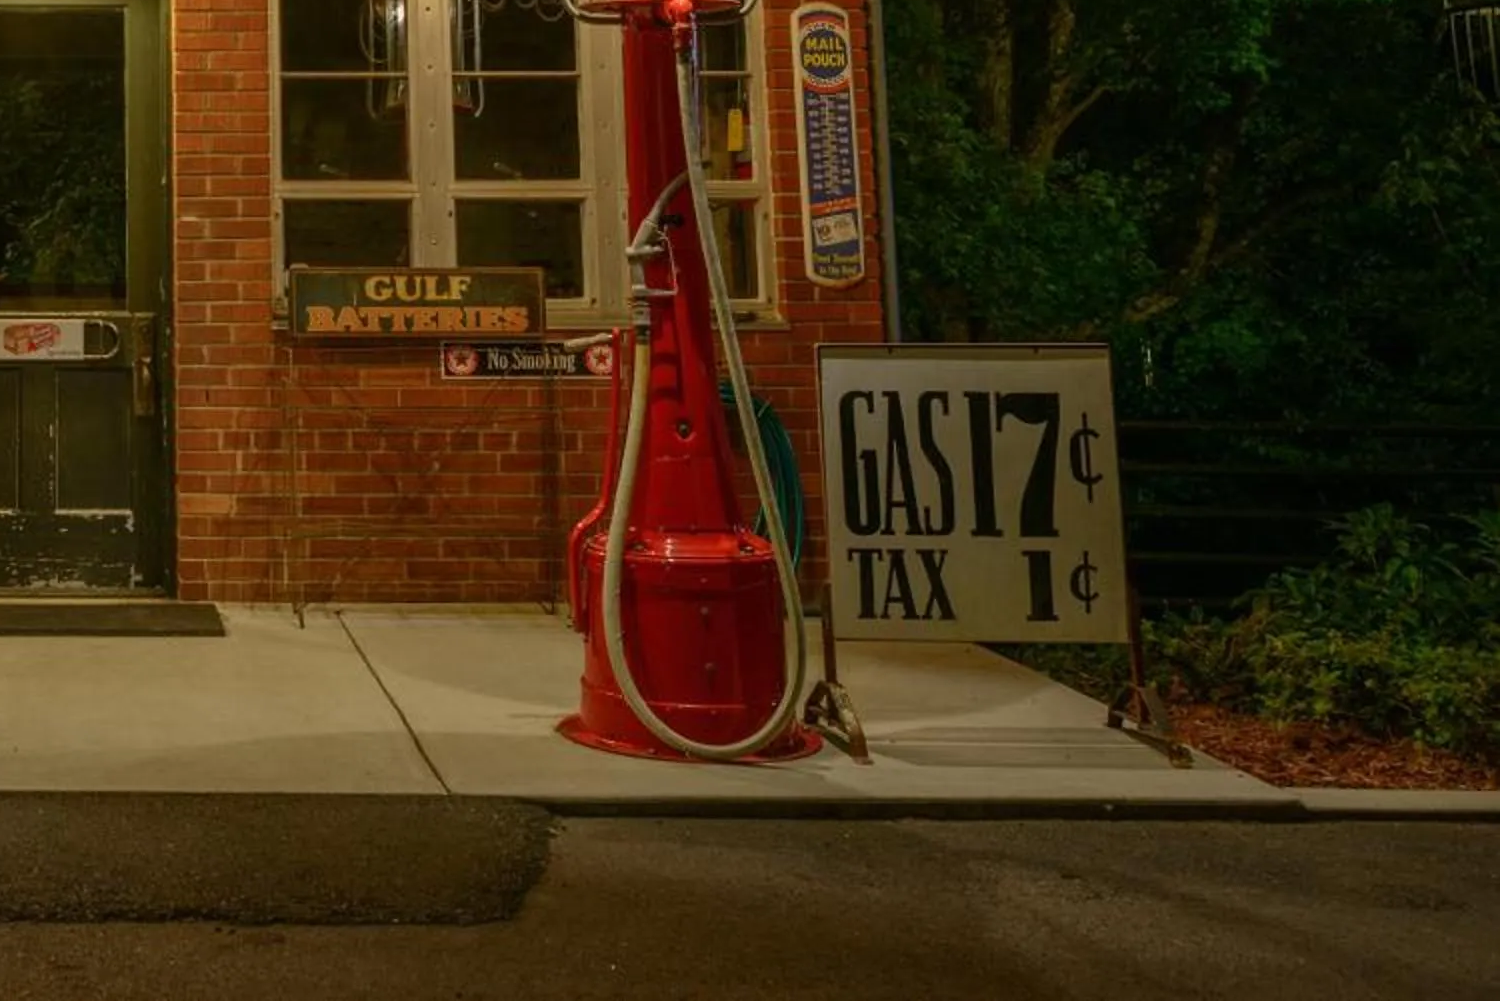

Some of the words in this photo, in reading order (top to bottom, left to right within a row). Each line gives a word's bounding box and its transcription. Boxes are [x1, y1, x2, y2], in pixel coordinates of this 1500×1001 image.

[806, 36, 844, 51] MAIL
[803, 52, 846, 68] POUCH
[364, 274, 472, 301] GULF
[306, 305, 528, 332] BATTERIES
[485, 346, 509, 371] No
[839, 390, 956, 536] GAS
[847, 548, 957, 621] TAX
